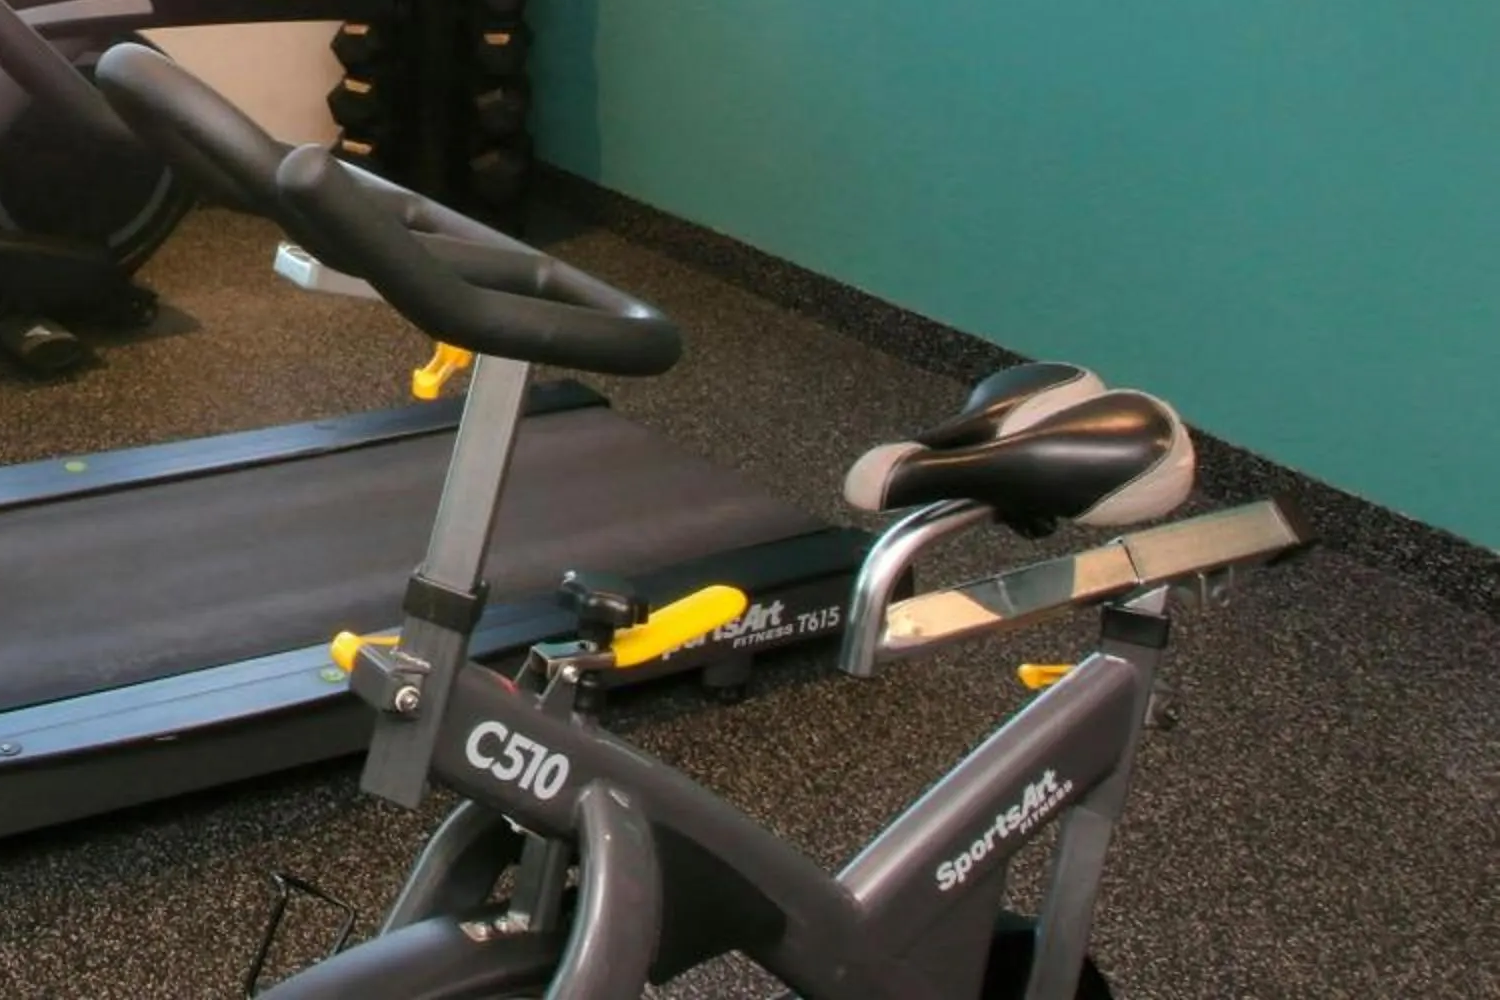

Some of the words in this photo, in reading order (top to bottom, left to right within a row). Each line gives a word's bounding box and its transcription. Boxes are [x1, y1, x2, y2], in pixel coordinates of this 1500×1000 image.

[732, 623, 794, 650] FITNESS
[797, 606, 841, 634] T615
[465, 720, 570, 800] C510
[936, 769, 1057, 891] SportsArt
